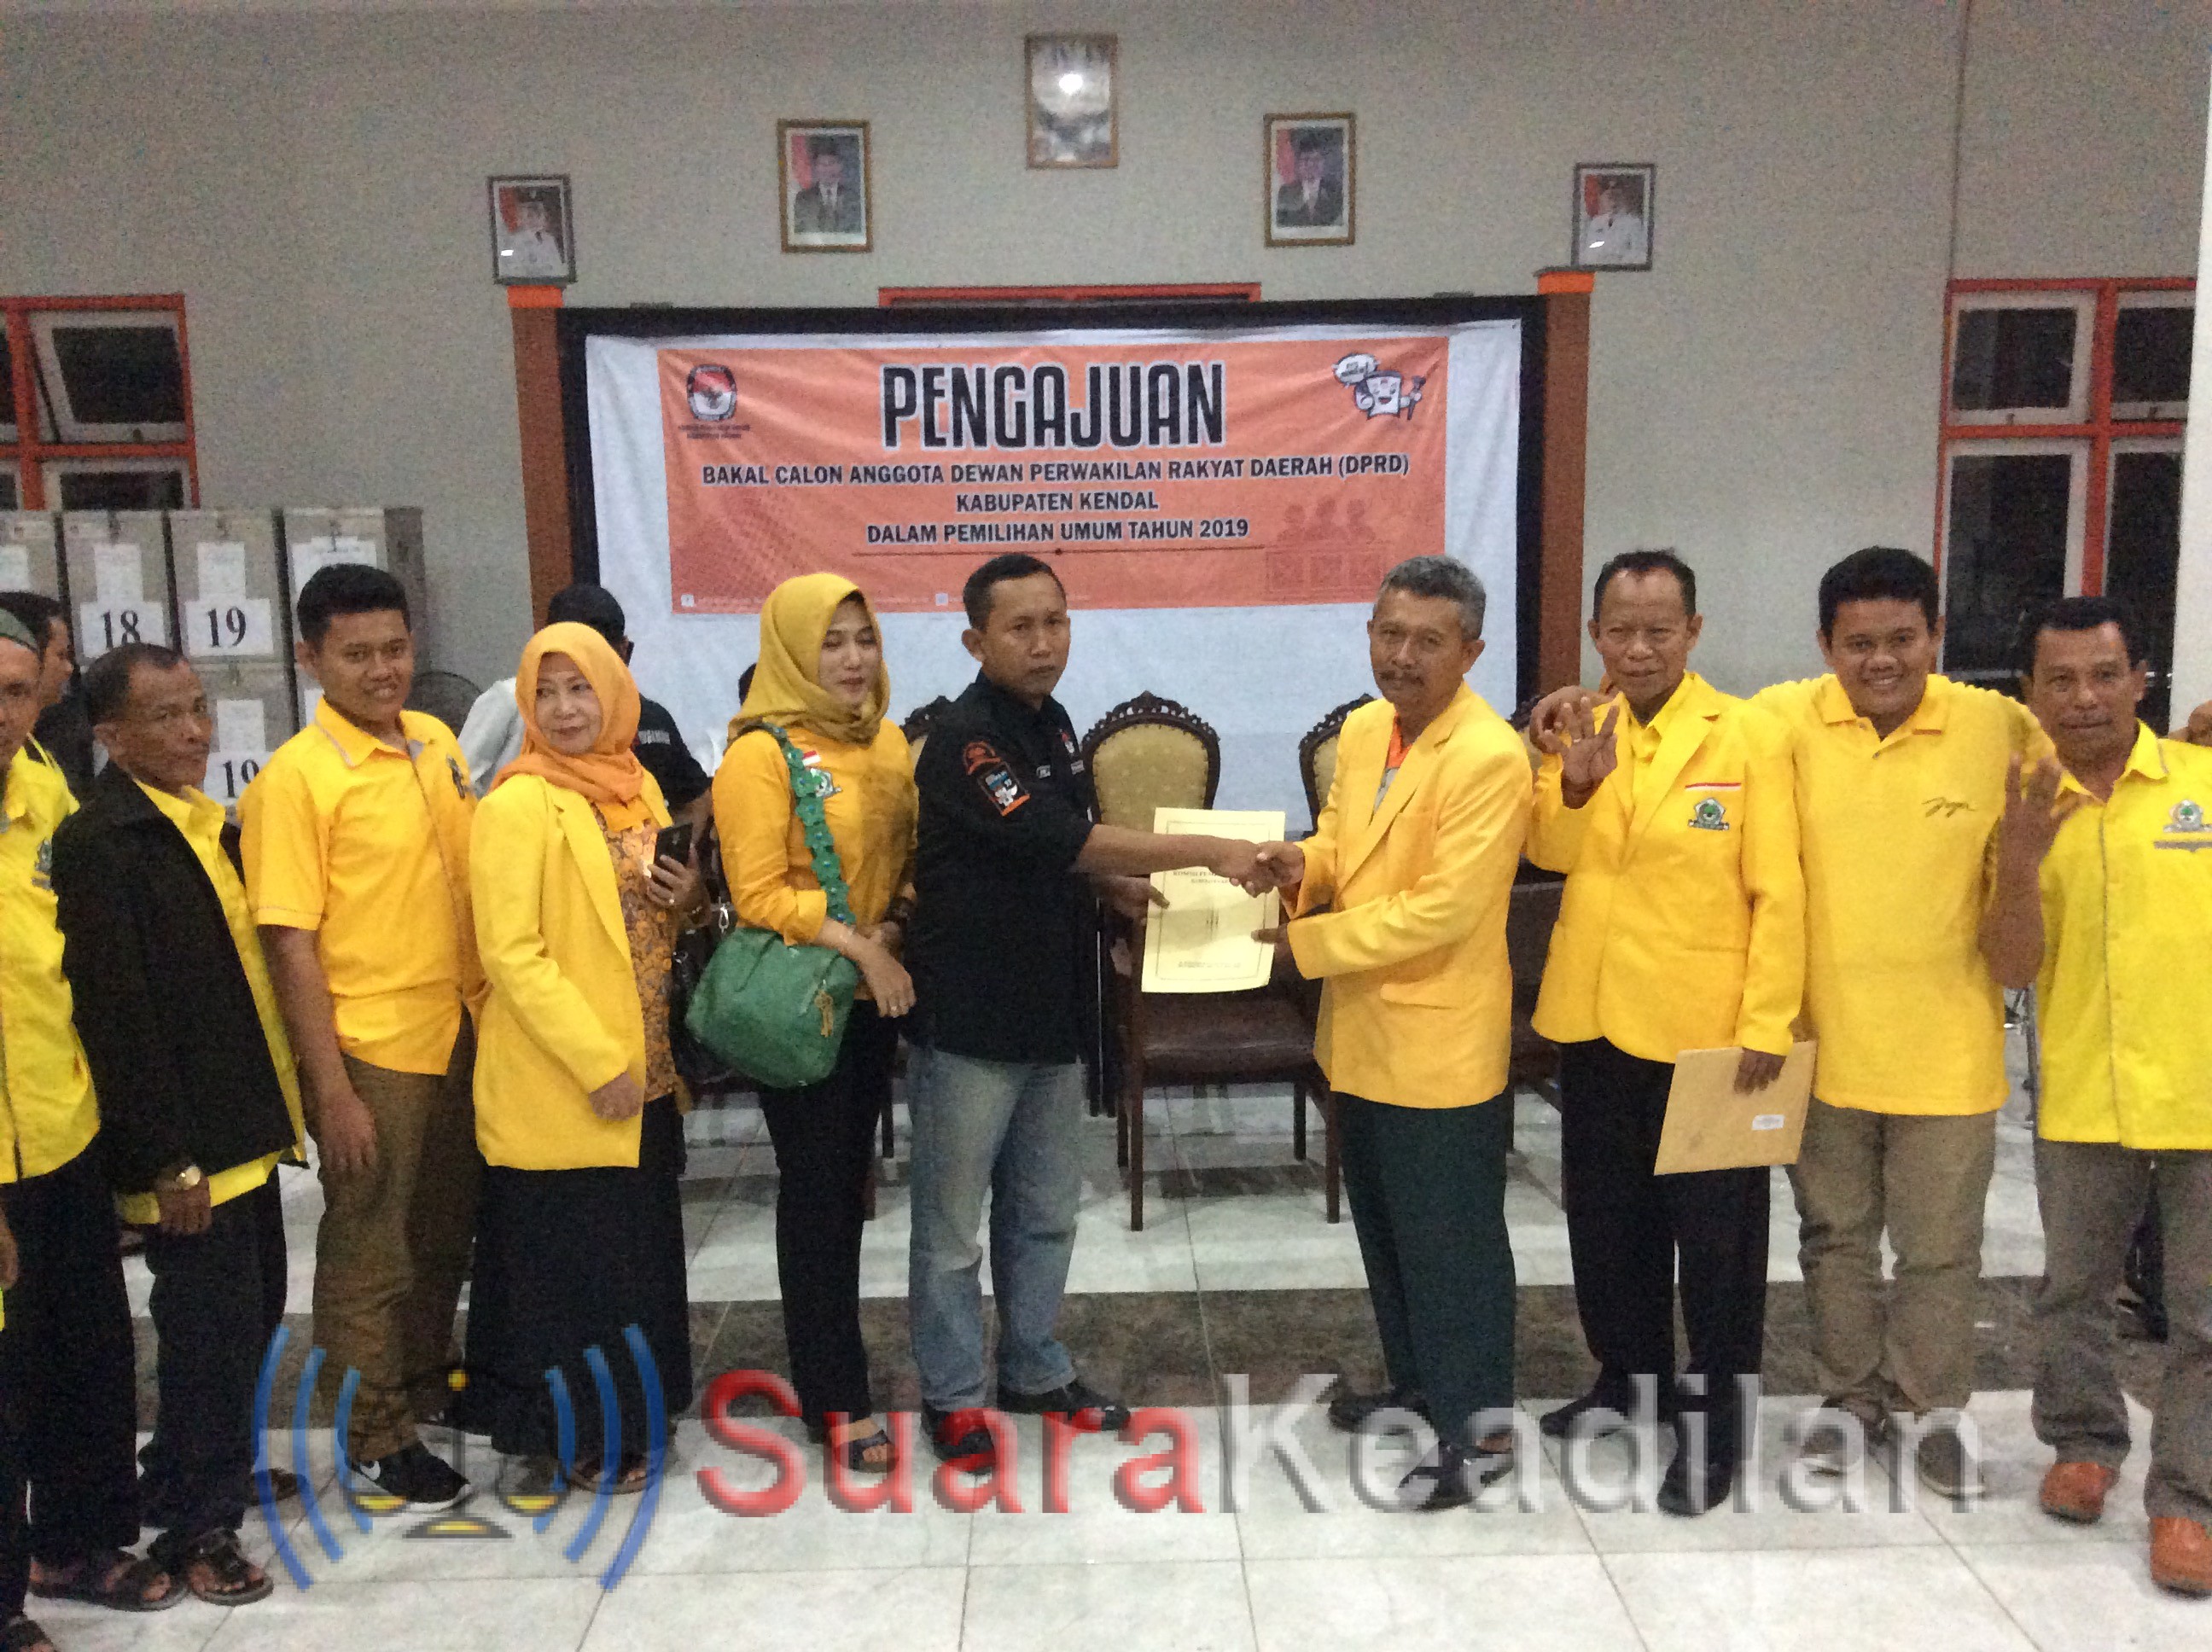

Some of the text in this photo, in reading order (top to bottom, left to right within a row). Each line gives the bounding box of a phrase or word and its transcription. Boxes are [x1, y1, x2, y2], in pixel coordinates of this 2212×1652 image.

[884, 363, 1224, 448] PENGAJUAN
[703, 454, 1409, 485] BAKAL CALON ANGGOTA DEWAN PERWAKILAN RAKYAT DAERAH (DPRD)
[957, 491, 1159, 512] KABUPATEN KENDAL
[867, 518, 1249, 543] DALAM PEMILIHAN UMUM TAHUN 2019
[102, 609, 141, 648] 18
[207, 606, 247, 648] 19
